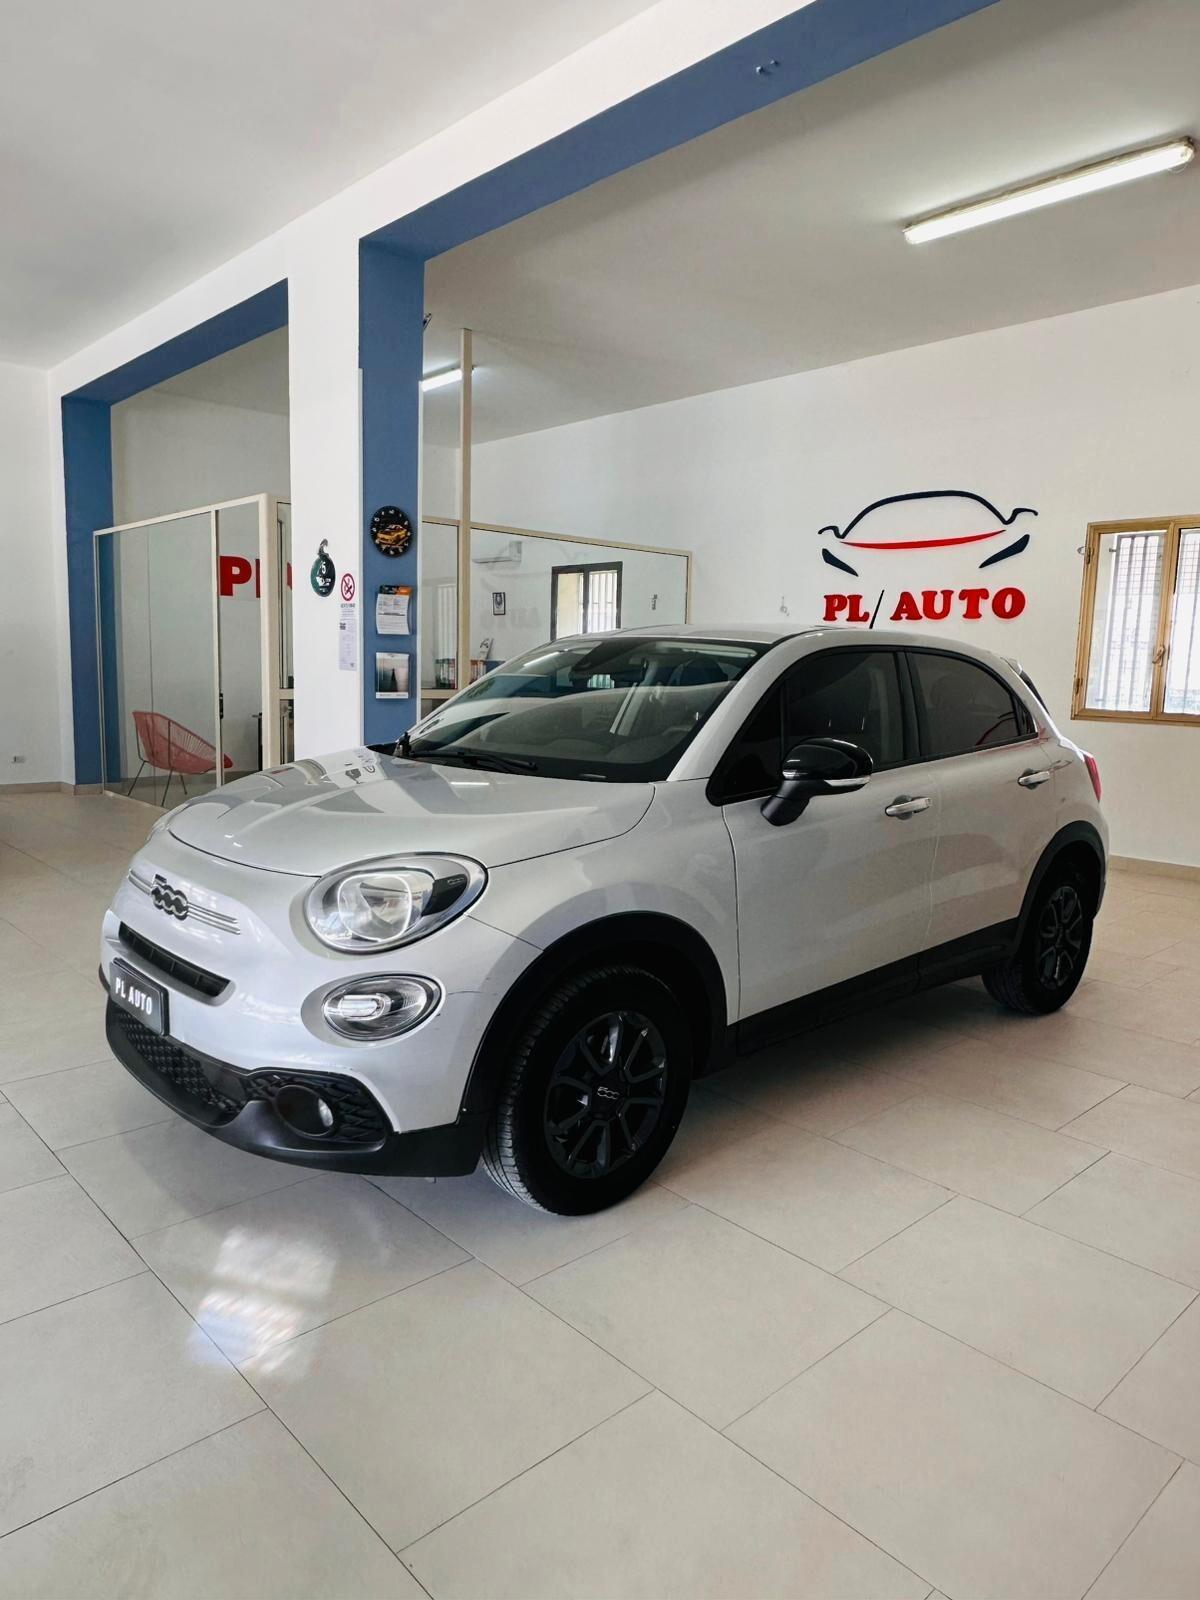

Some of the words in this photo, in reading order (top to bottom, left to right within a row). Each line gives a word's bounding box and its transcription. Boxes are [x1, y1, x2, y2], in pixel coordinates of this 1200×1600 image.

[889, 587, 1026, 621] AUTO
[115, 977, 126, 999] PL
[128, 986, 153, 1015] AUTO
